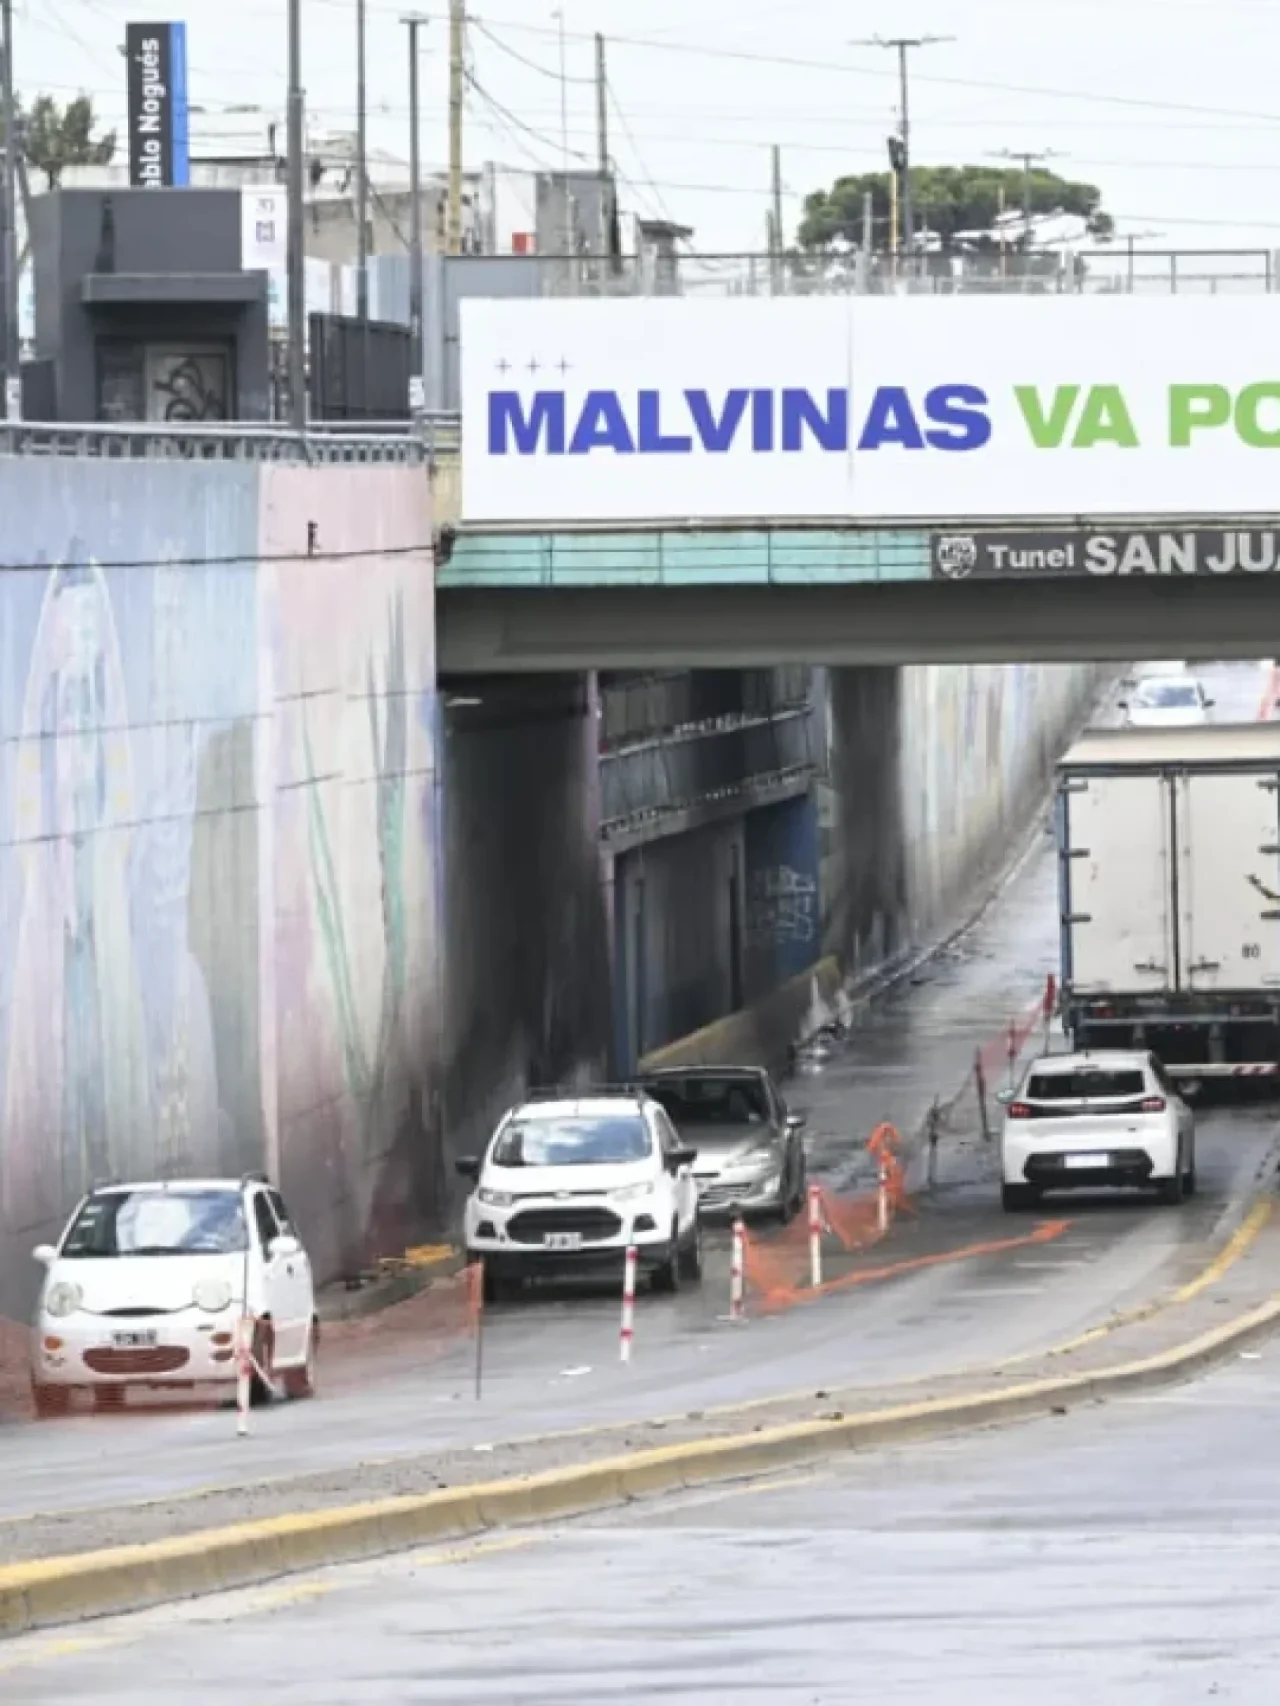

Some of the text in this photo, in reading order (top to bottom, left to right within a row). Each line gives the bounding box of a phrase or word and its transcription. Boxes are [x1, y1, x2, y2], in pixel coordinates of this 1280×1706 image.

[133, 37, 166, 188] ablo Nogués
[487, 384, 992, 455] MALVINAS
[1013, 383, 1140, 448] VA
[986, 544, 1075, 570] Tunel
[1083, 532, 1197, 575] SAN
